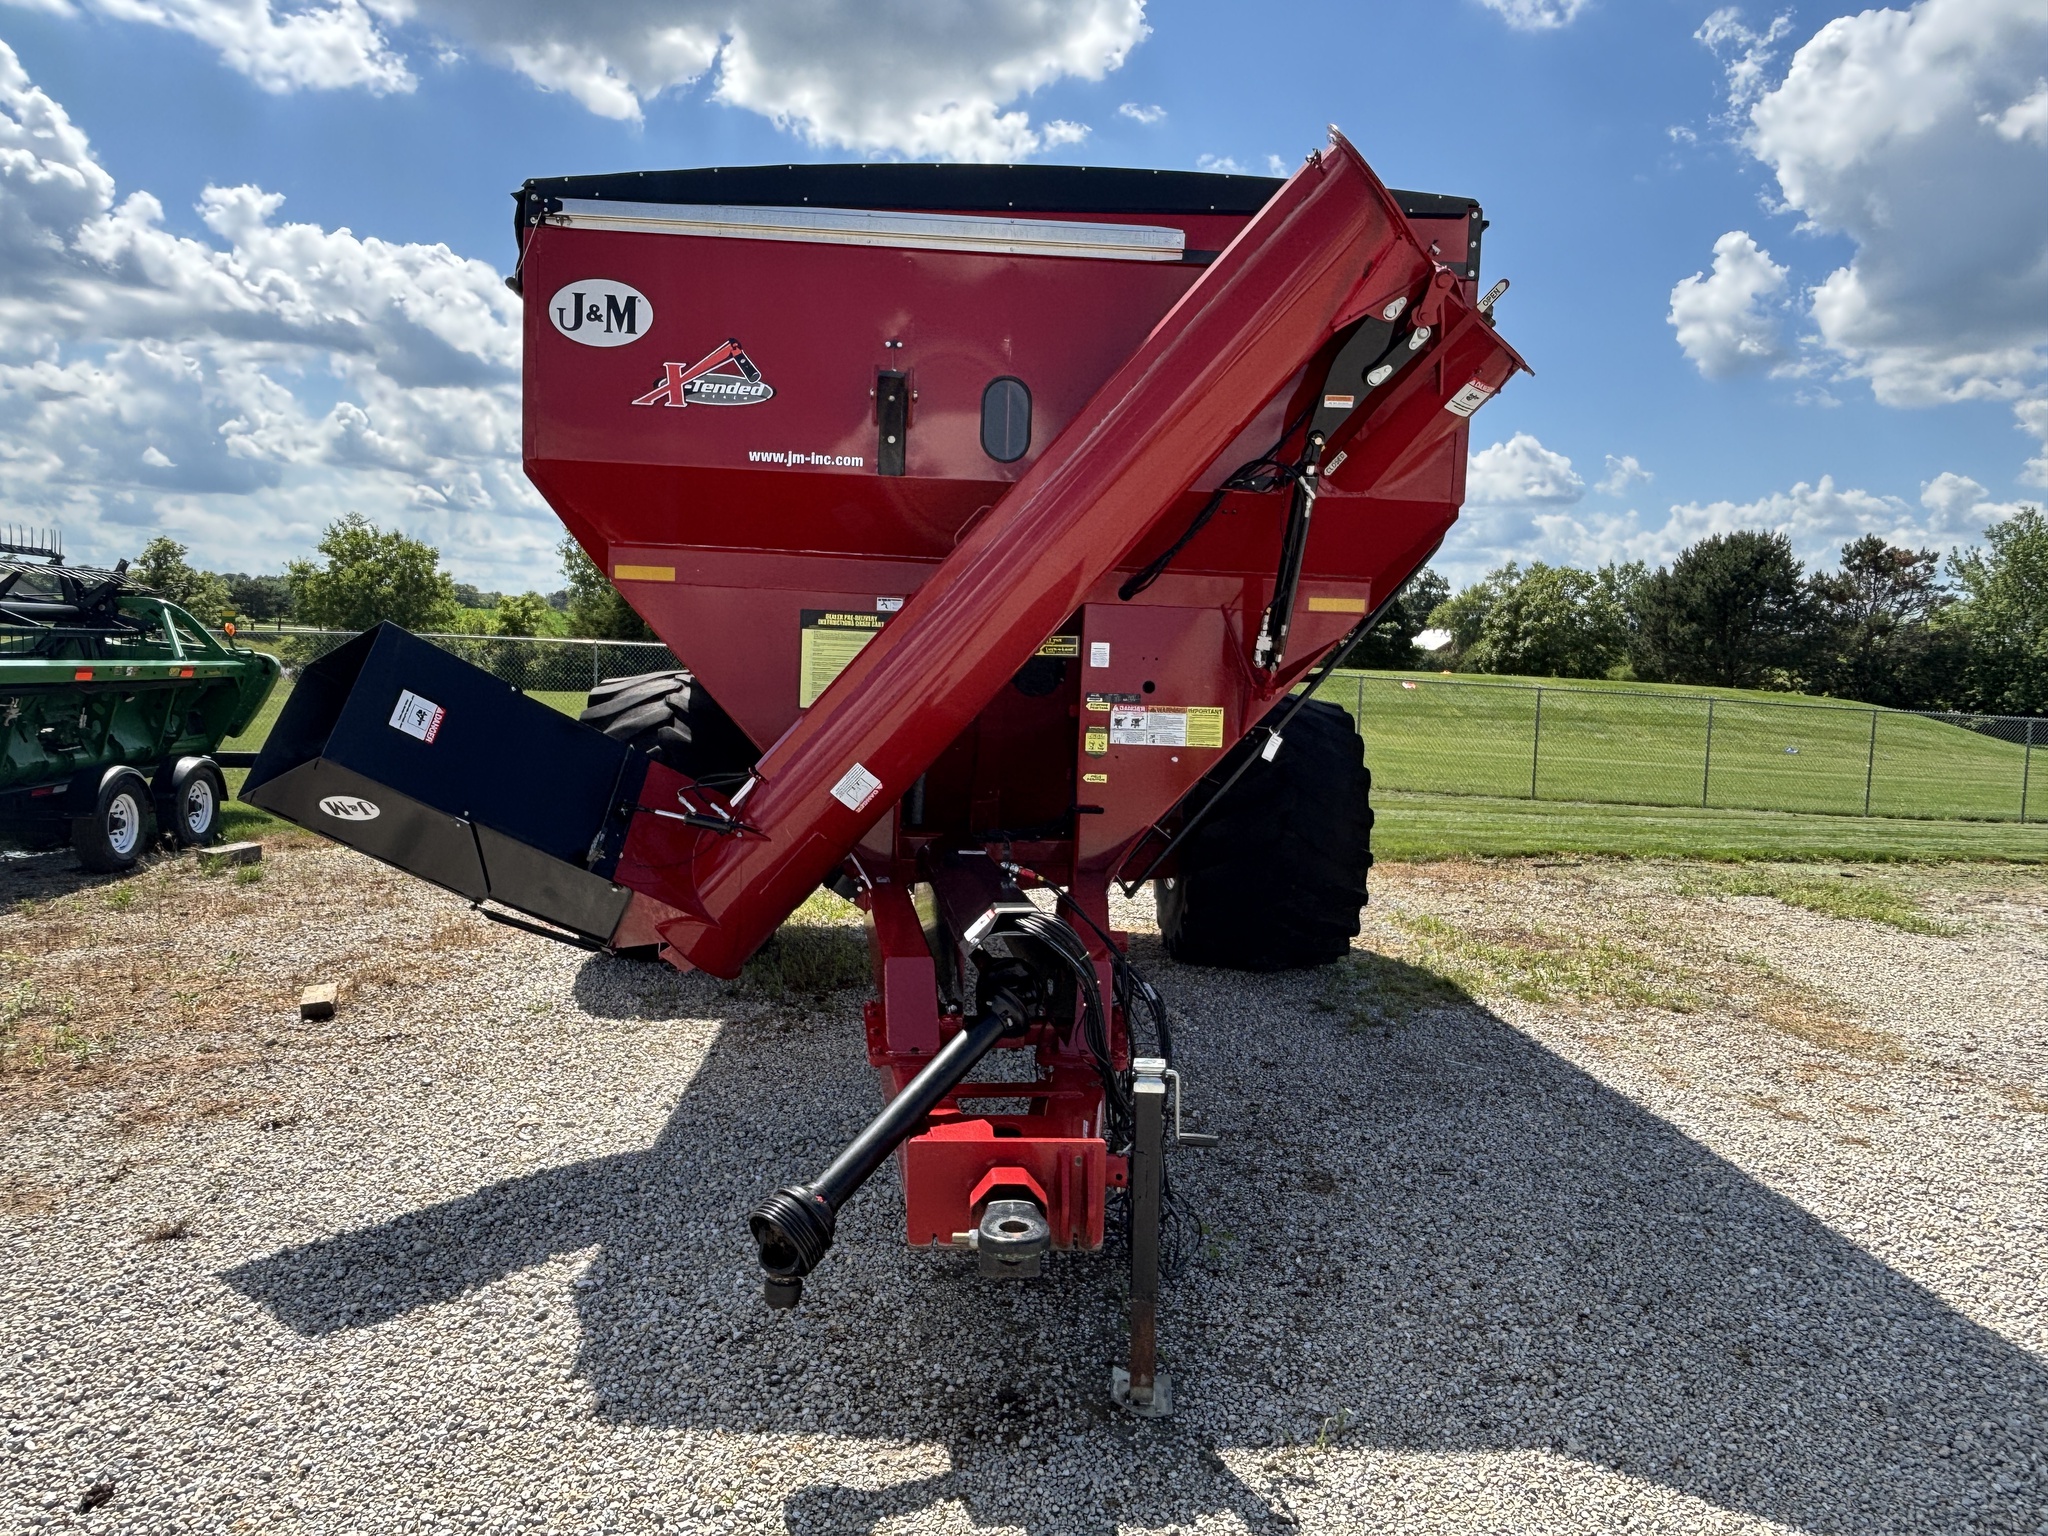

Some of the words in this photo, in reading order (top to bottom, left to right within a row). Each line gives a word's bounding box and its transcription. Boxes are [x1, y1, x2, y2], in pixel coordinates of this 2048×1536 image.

[1482, 288, 1501, 307] OPEN
[556, 292, 639, 335] J&M
[631, 361, 766, 407] X-Tended
[748, 450, 864, 467] www.jm-inc.com
[1325, 453, 1345, 474] CLOSED
[425, 711, 444, 744] DANGER
[322, 801, 376, 816] J&M
